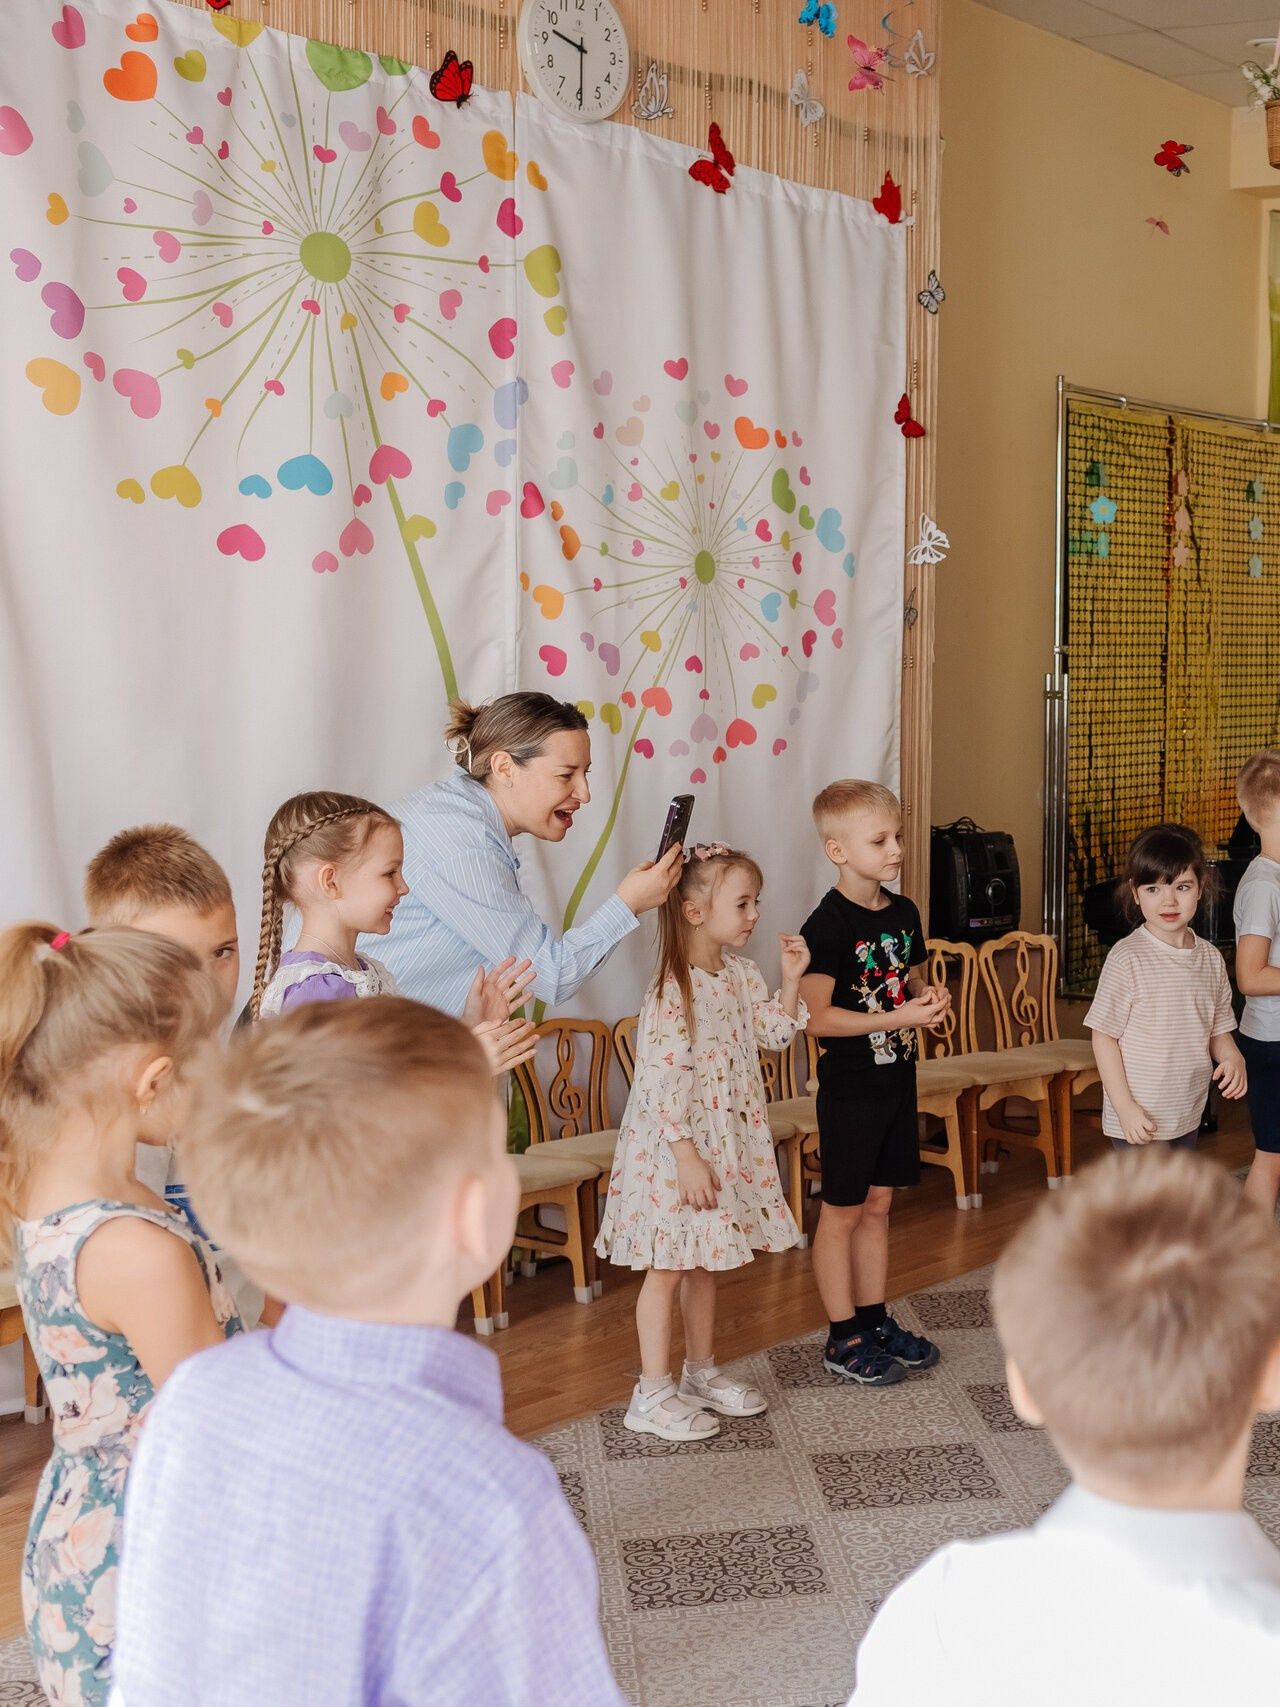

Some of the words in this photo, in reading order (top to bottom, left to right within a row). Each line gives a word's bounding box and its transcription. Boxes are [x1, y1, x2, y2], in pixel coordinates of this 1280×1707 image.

[547, 9, 558, 26] 10
[541, 31, 549, 45] 9
[604, 28, 611, 42] 2
[547, 54, 554, 68] 8
[609, 52, 616, 66] 3
[558, 75, 566, 89] 7
[604, 71, 611, 85] 4
[594, 86, 601, 100] 5
